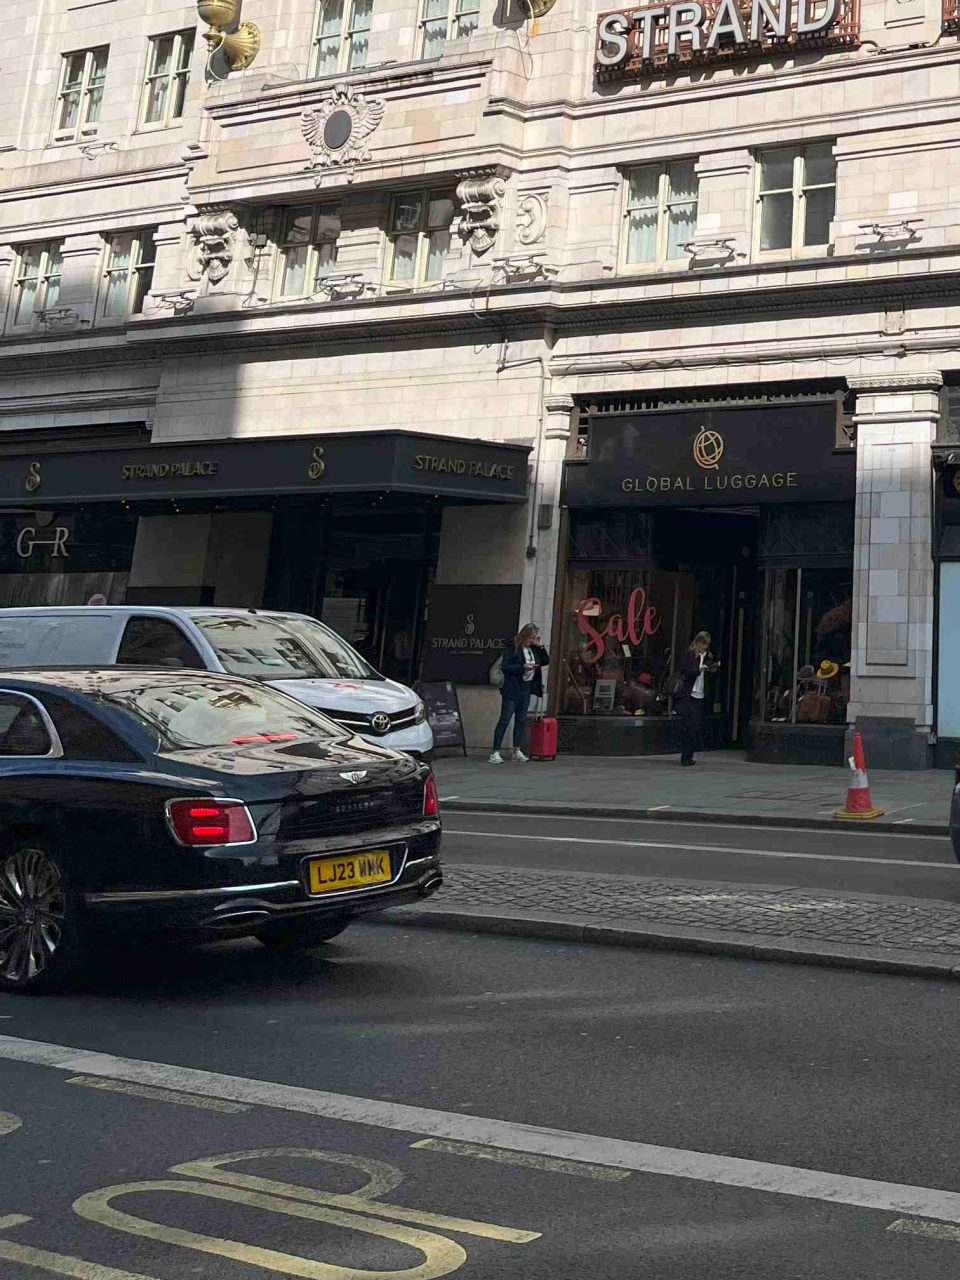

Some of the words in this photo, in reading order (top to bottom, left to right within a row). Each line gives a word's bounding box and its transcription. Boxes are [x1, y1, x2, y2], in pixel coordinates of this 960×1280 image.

[121, 463, 170, 480] STRAND
[170, 460, 219, 477] PALACE
[413, 454, 466, 474] STRAND
[467, 460, 515, 480] PALACE
[621, 476, 696, 493] GLOBAL
[704, 472, 798, 490] LUGGAGE
[577, 586, 662, 664] Sale
[431, 637, 468, 649] STRAND
[469, 637, 506, 650] PALACE
[317, 861, 355, 885] LJ23
